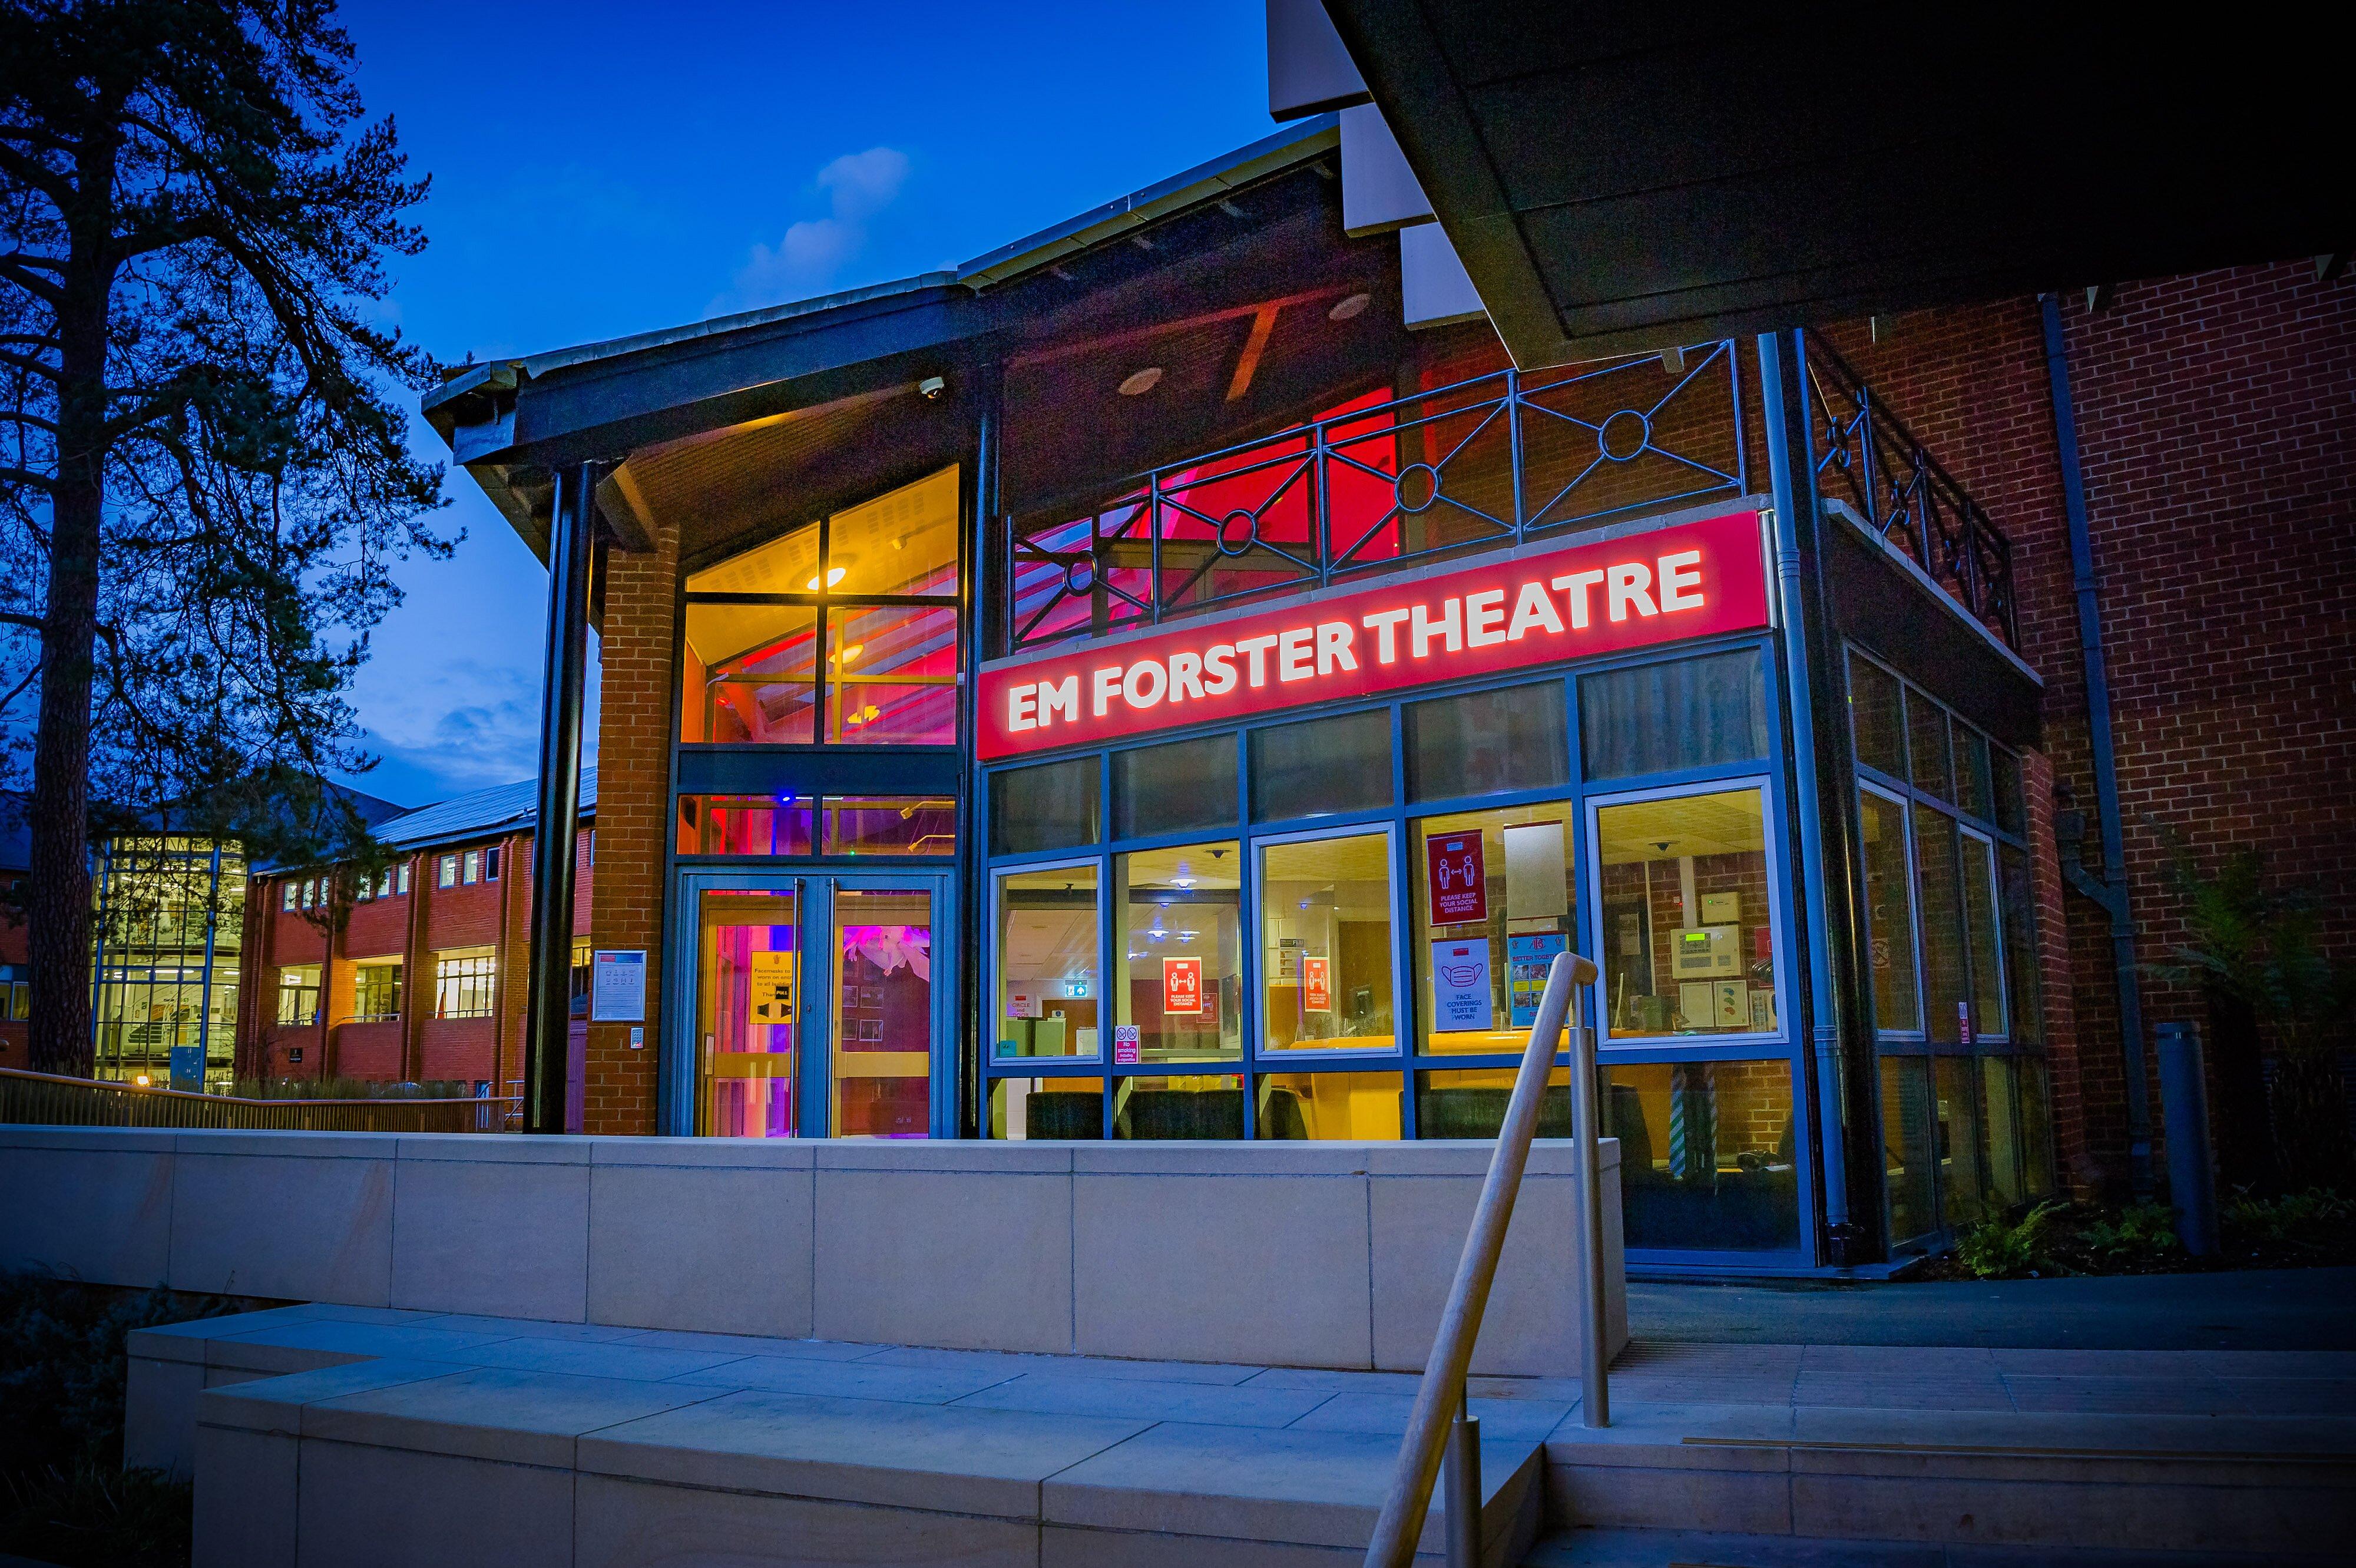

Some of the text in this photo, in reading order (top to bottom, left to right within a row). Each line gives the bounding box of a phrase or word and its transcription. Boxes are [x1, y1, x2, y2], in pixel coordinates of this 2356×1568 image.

[1007, 550, 1706, 732] EM FORSTER THEATRE
[1441, 894, 1461, 902] PLEASE
[1445, 905, 1474, 914] DISTANCE
